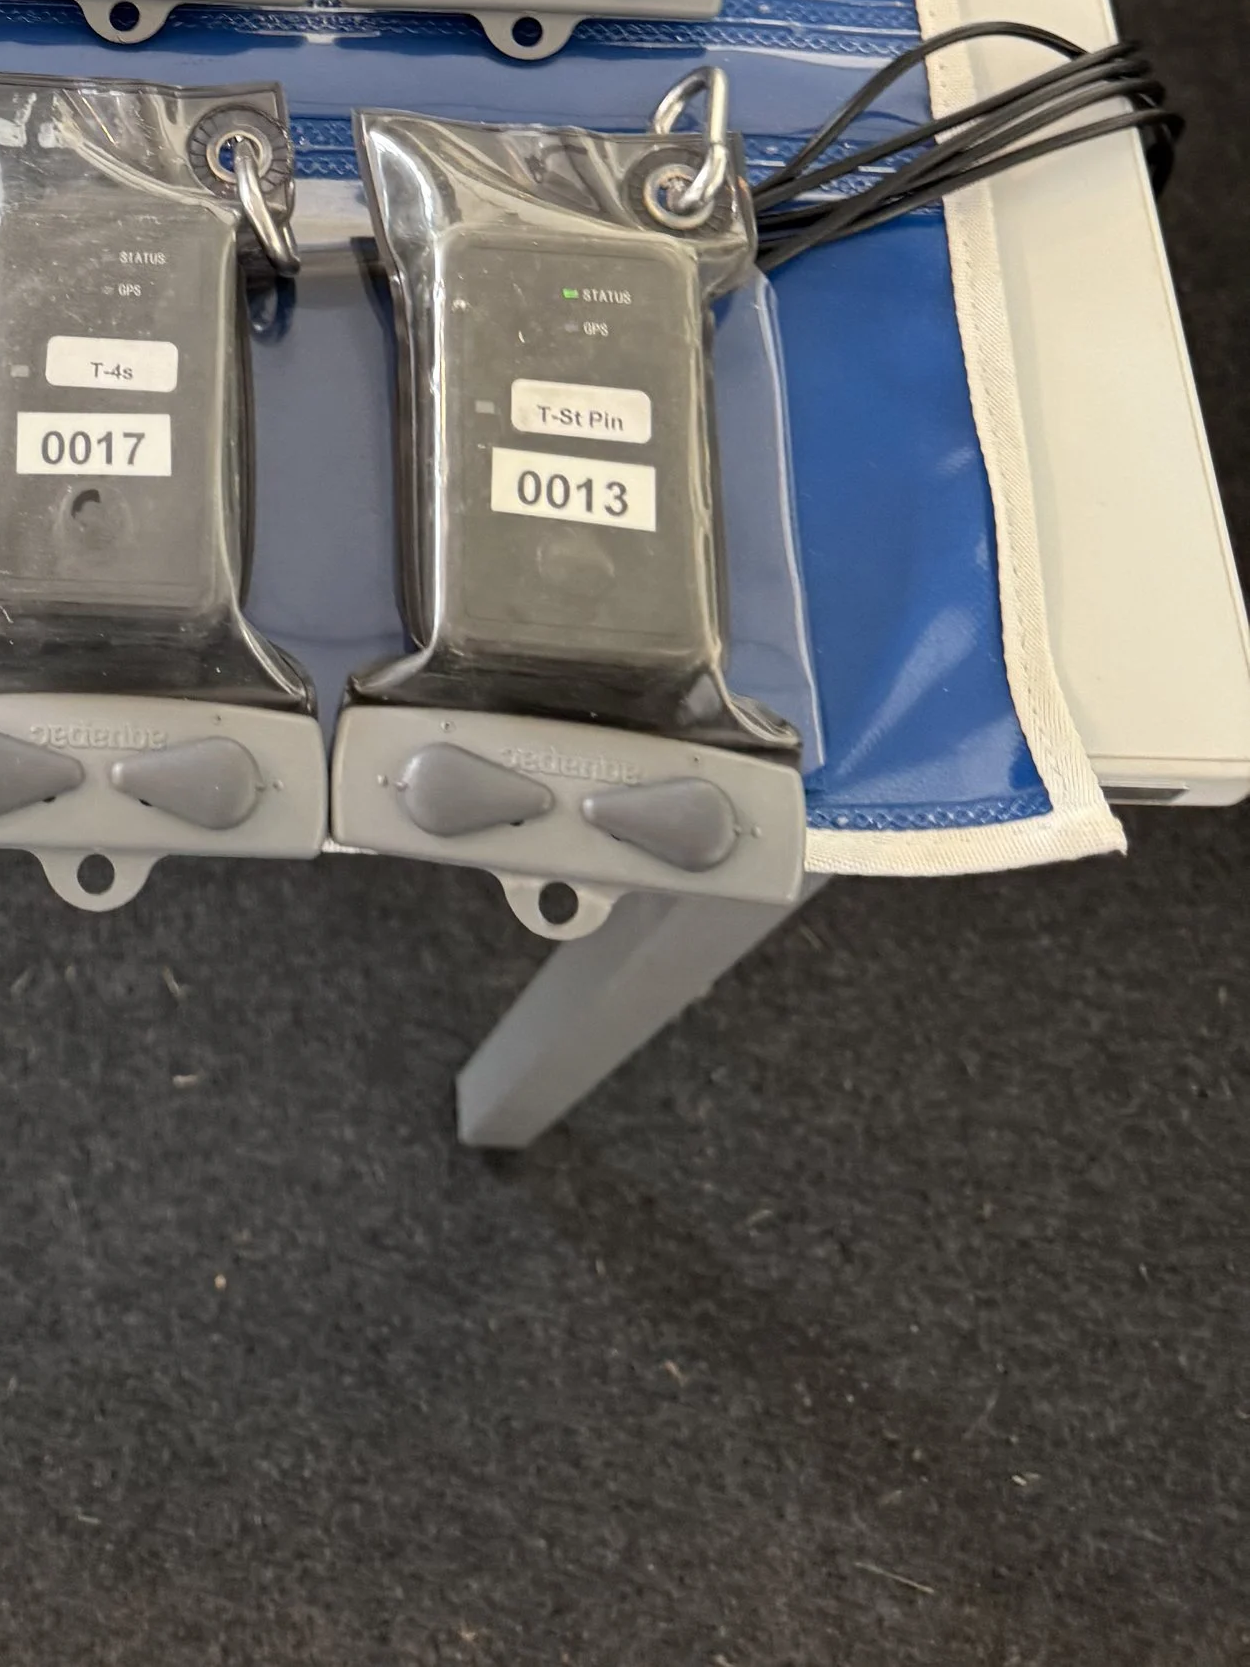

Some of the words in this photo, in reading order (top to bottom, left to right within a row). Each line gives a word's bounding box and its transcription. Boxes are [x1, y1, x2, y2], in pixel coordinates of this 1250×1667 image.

[118, 250, 167, 265] STATUS
[117, 283, 142, 297] GPS
[582, 287, 633, 305] STATUS
[582, 320, 610, 337] GPS
[90, 360, 134, 381] T-4s
[536, 404, 583, 428] T-St
[588, 410, 625, 432] Pin
[40, 429, 146, 466] 0017
[516, 469, 629, 518] 0013
